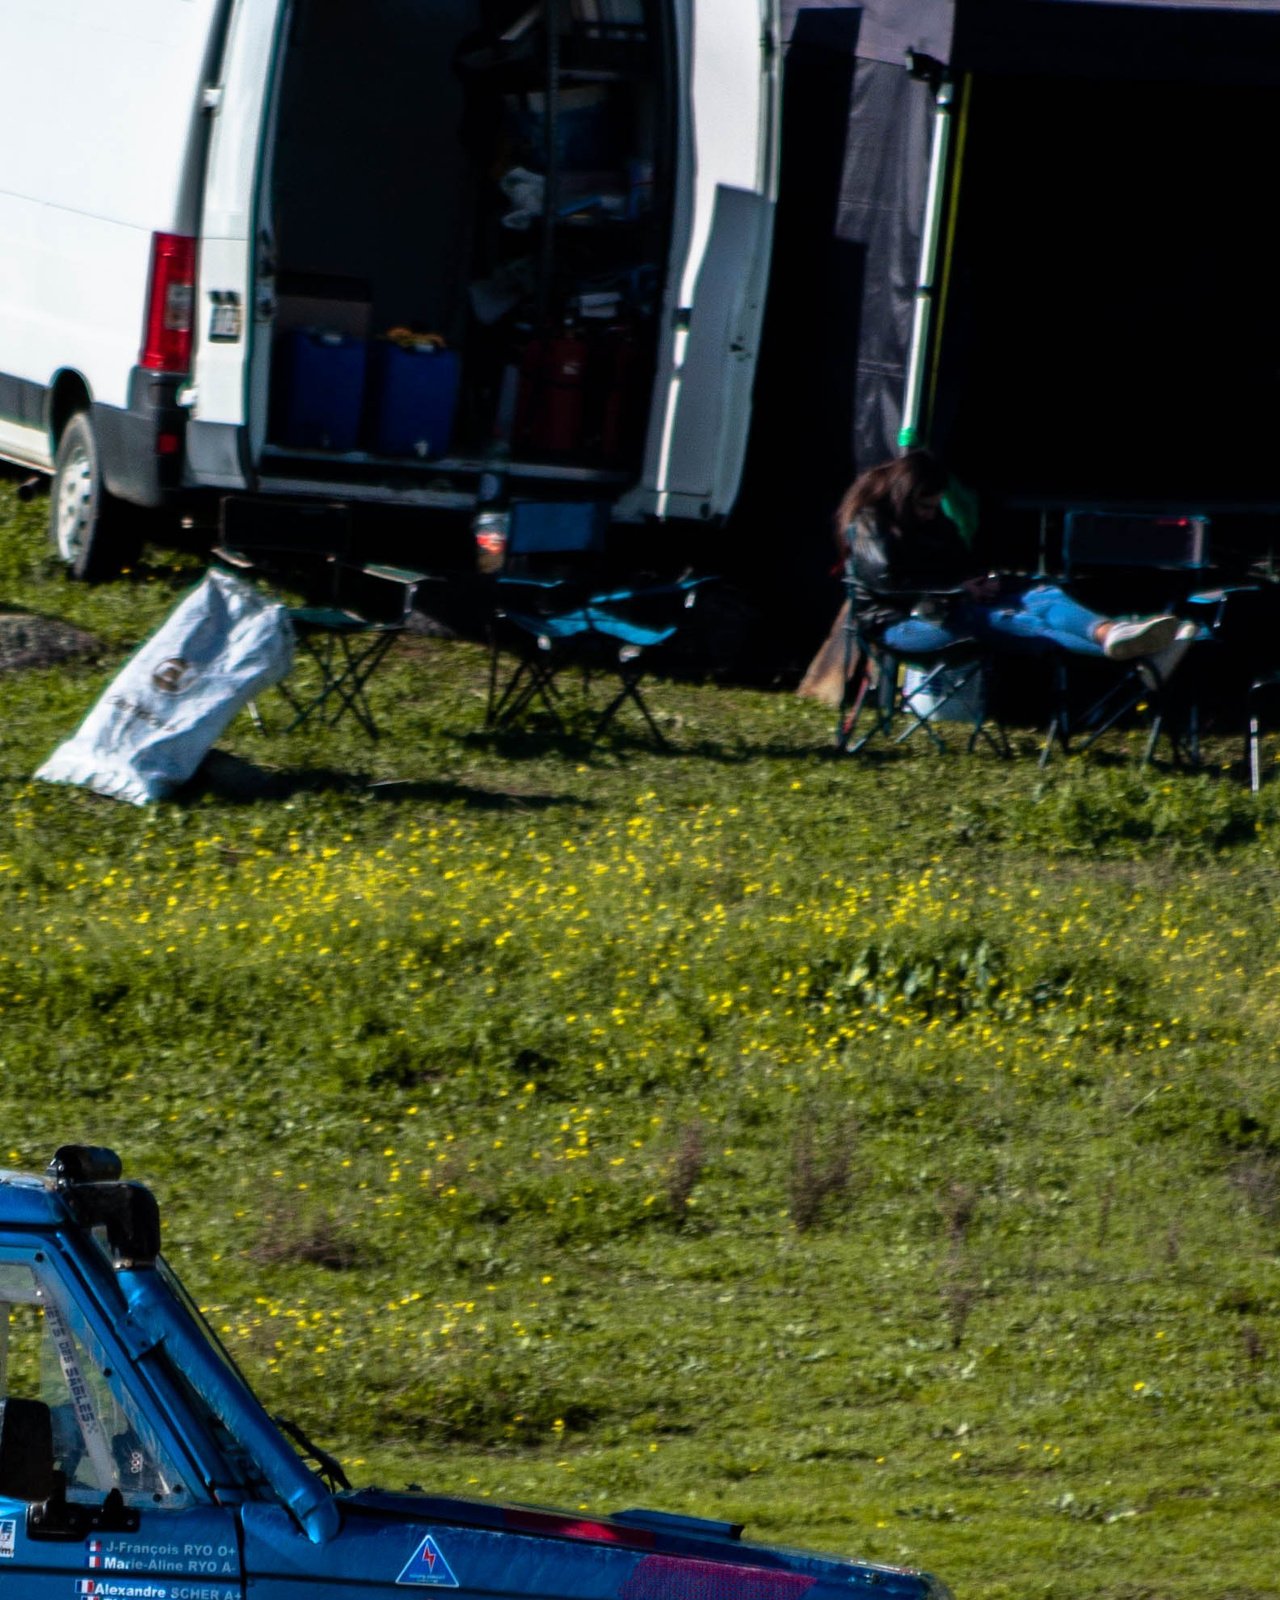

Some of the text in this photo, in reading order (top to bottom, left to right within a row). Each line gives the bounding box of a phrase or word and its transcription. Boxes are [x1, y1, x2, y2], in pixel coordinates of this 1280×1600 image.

[45, 1305, 66, 1338] ETS
[65, 1366, 95, 1423] SABLES
[106, 1542, 179, 1556] J-François
[184, 1544, 212, 1556] RYO
[104, 1557, 236, 1572] Marie-Aline RYO A-
[94, 1583, 242, 1600] Alexandre SCHER A+
